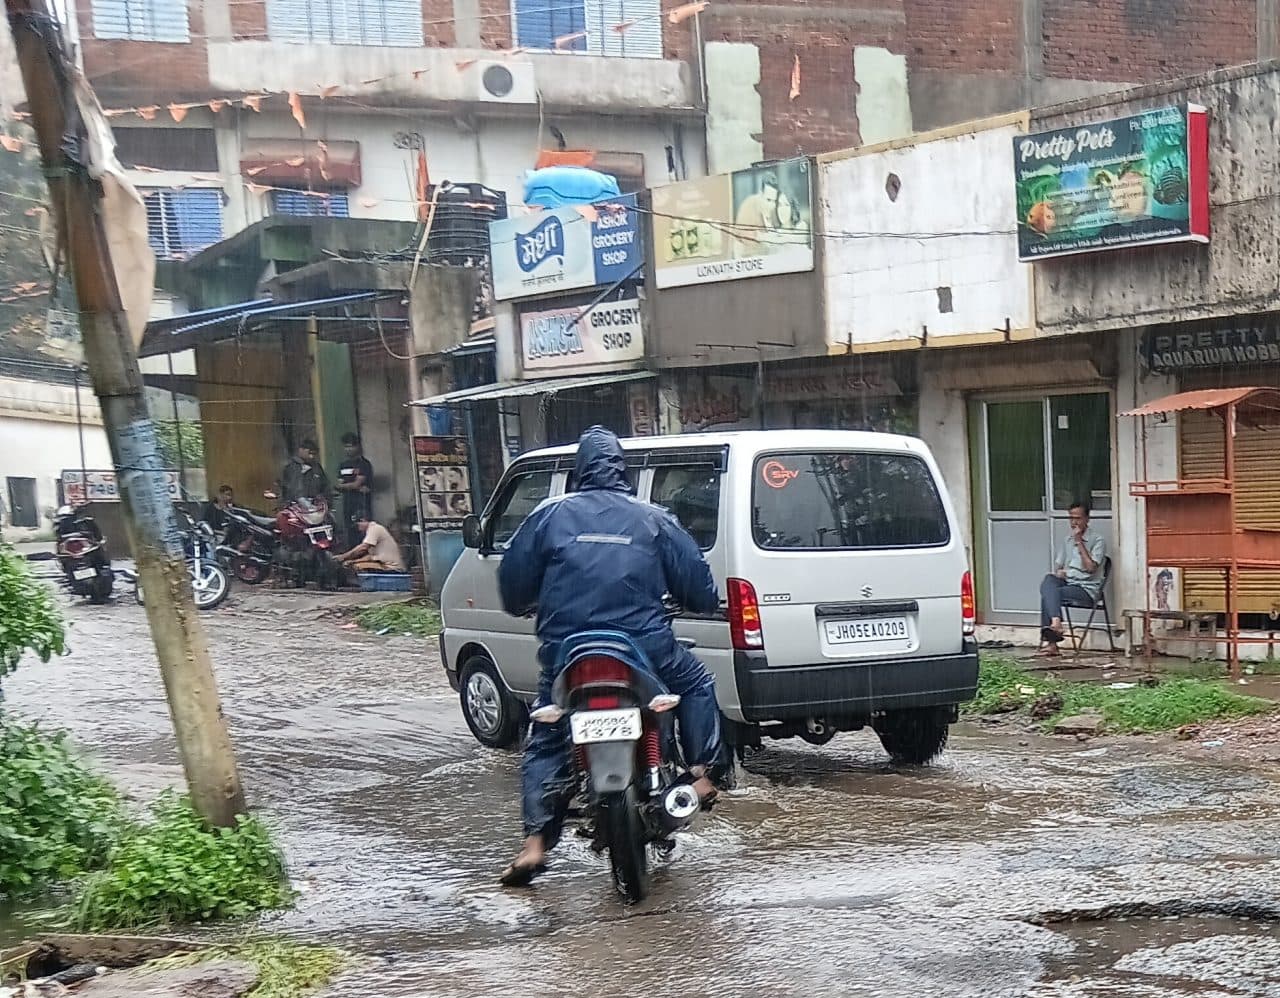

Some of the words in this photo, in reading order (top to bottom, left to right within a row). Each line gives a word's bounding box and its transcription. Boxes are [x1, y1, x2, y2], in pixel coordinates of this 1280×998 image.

[1020, 134, 1077, 162] Pretty
[1076, 127, 1116, 153] Pets
[596, 212, 628, 230] ASHOK
[593, 230, 636, 249] GROCERY
[602, 250, 628, 266] SHOP
[736, 258, 764, 273] STORE
[591, 308, 641, 328] GROCERY
[603, 331, 632, 351] SHOP
[1155, 328, 1266, 350] PRETTY
[1152, 345, 1232, 369] AQUARIUM
[835, 621, 905, 640] JH05EA0209
